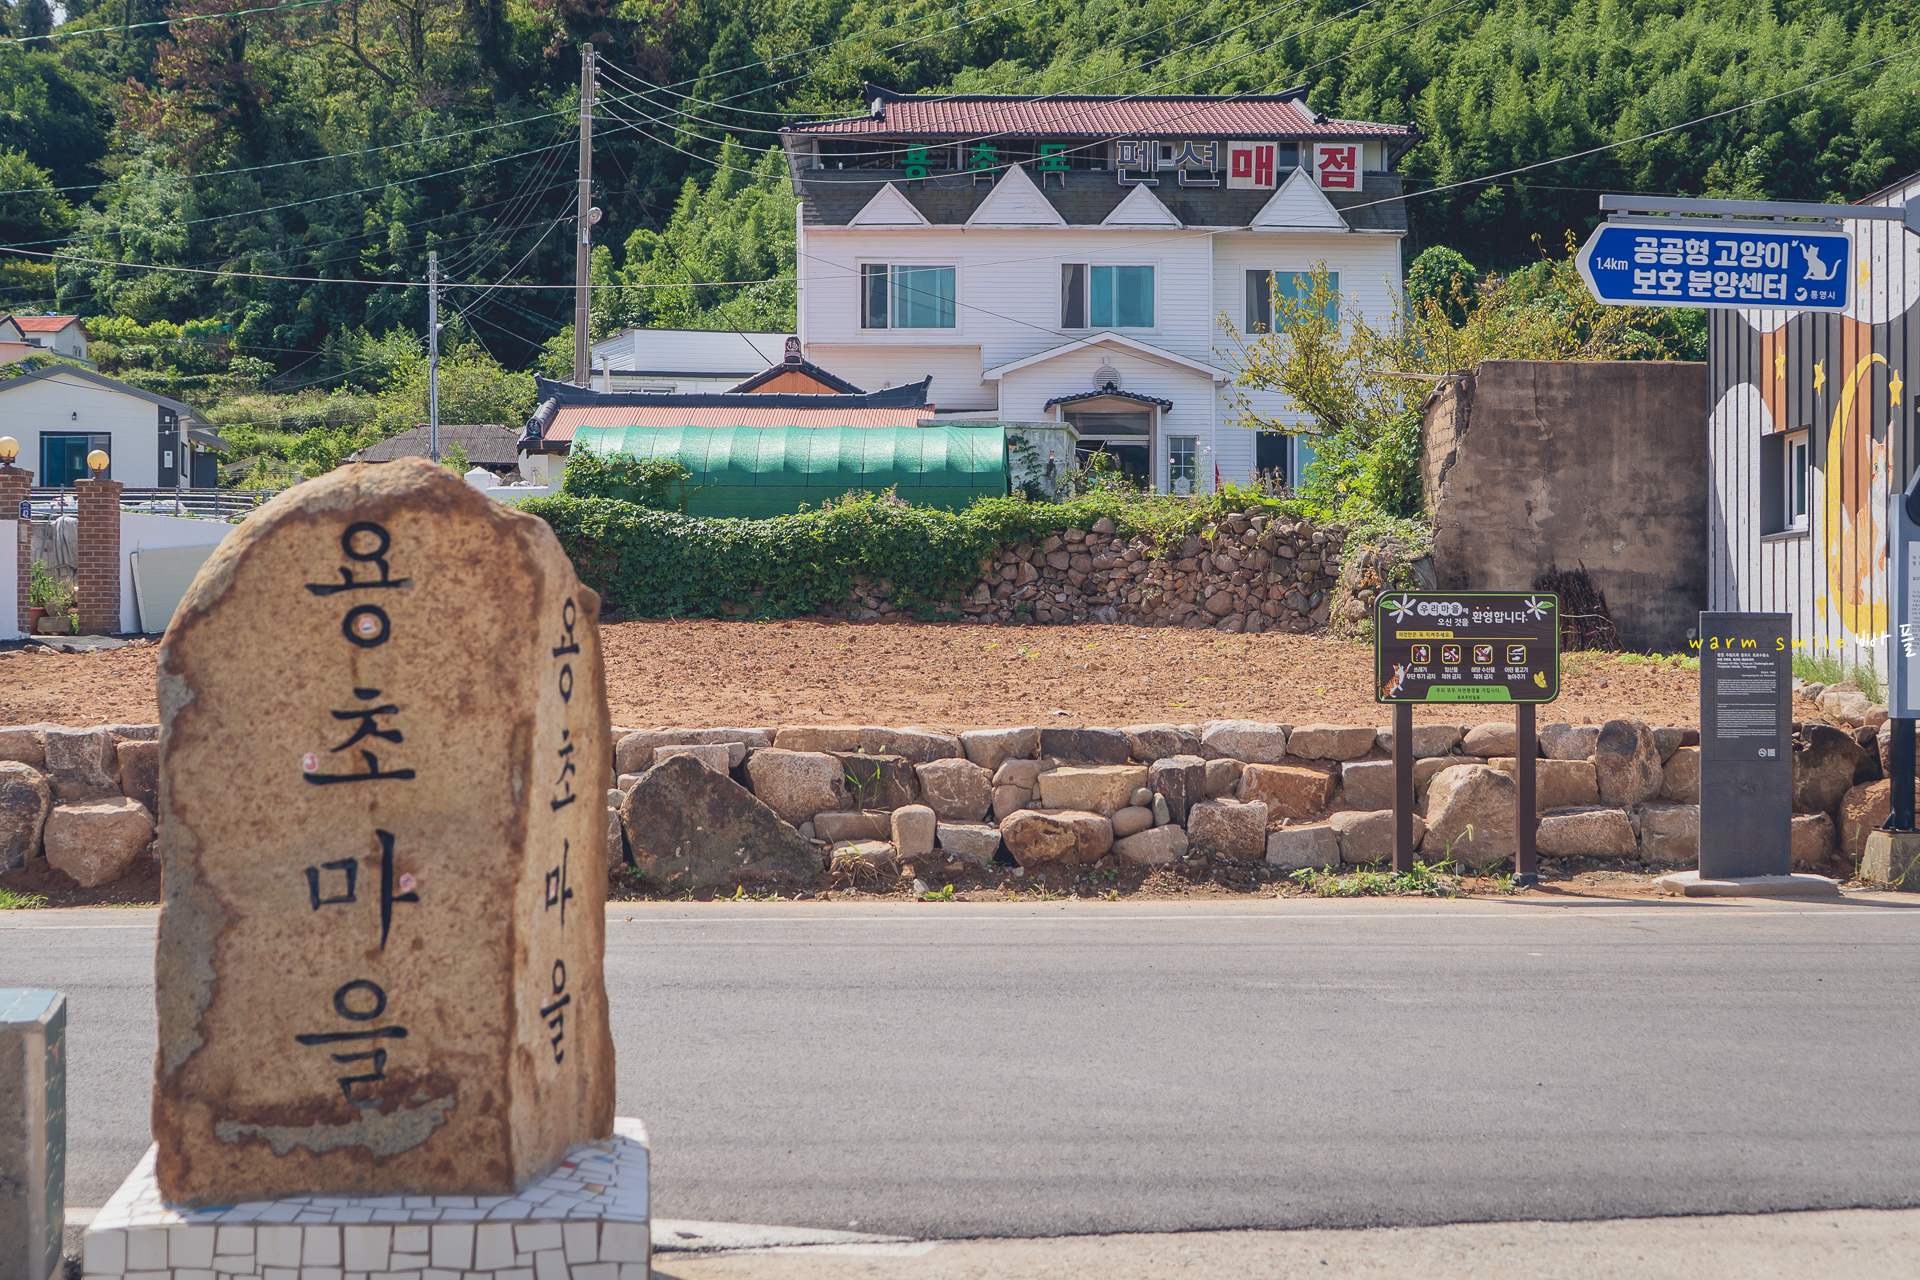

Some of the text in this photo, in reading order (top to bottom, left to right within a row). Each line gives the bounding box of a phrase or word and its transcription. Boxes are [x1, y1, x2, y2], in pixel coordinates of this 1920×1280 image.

[901, 140, 1357, 189] 용초도 펜션 매점
[1596, 256, 1629, 270] 1.4km
[1634, 236, 1789, 270] 공공형 고양이
[1632, 268, 1788, 300] 보호 분양센터
[1810, 289, 1836, 300] 통영시
[1437, 617, 1469, 627] 오신 것을
[1471, 611, 1529, 624] 환영합니다.
[295, 520, 420, 1110] 용초마을
[539, 596, 581, 1066] 용초마을
